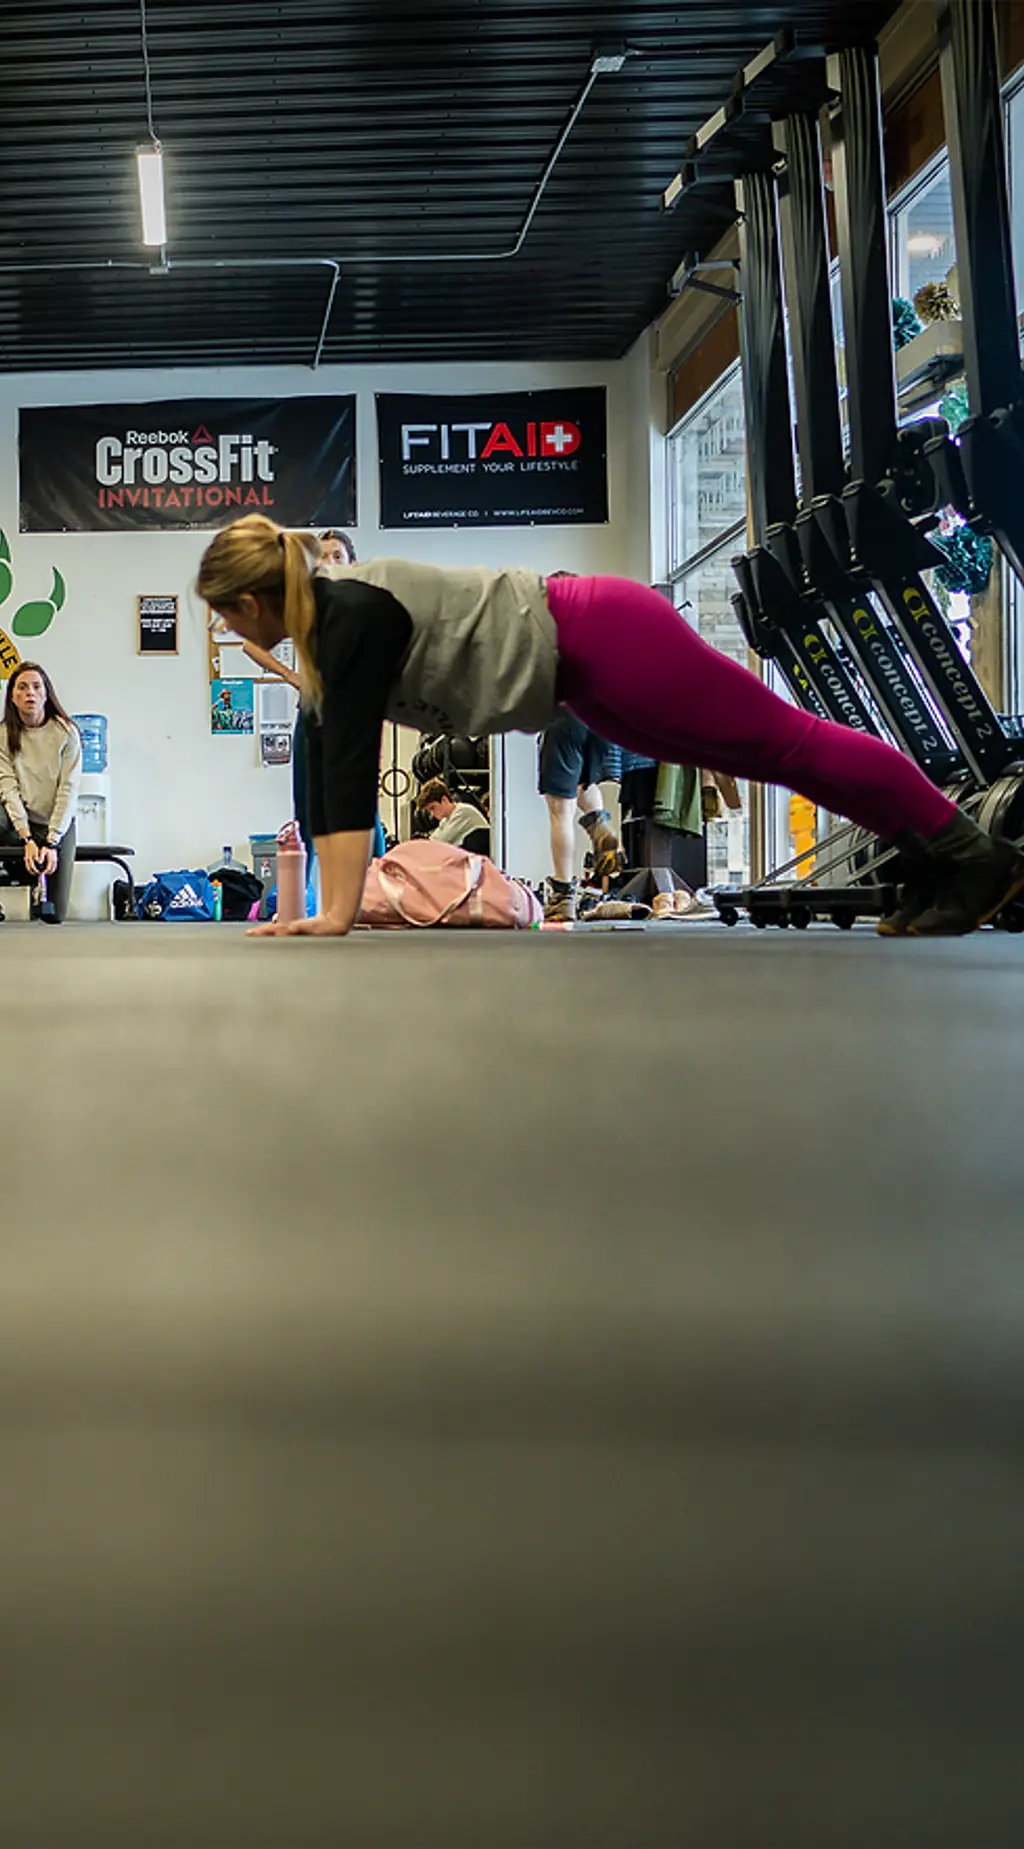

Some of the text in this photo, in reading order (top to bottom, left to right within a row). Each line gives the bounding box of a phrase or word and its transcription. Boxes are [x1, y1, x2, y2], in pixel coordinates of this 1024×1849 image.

[127, 430, 189, 445] Reebok
[401, 421, 582, 460] FITAID
[95, 434, 276, 486] CrossFit
[403, 460, 580, 475] SUPPLEMENT YOUR LIFESTYLE
[98, 485, 275, 508] INVITATIONAL
[976, 723, 993, 739] 2
[922, 735, 938, 751] 2
